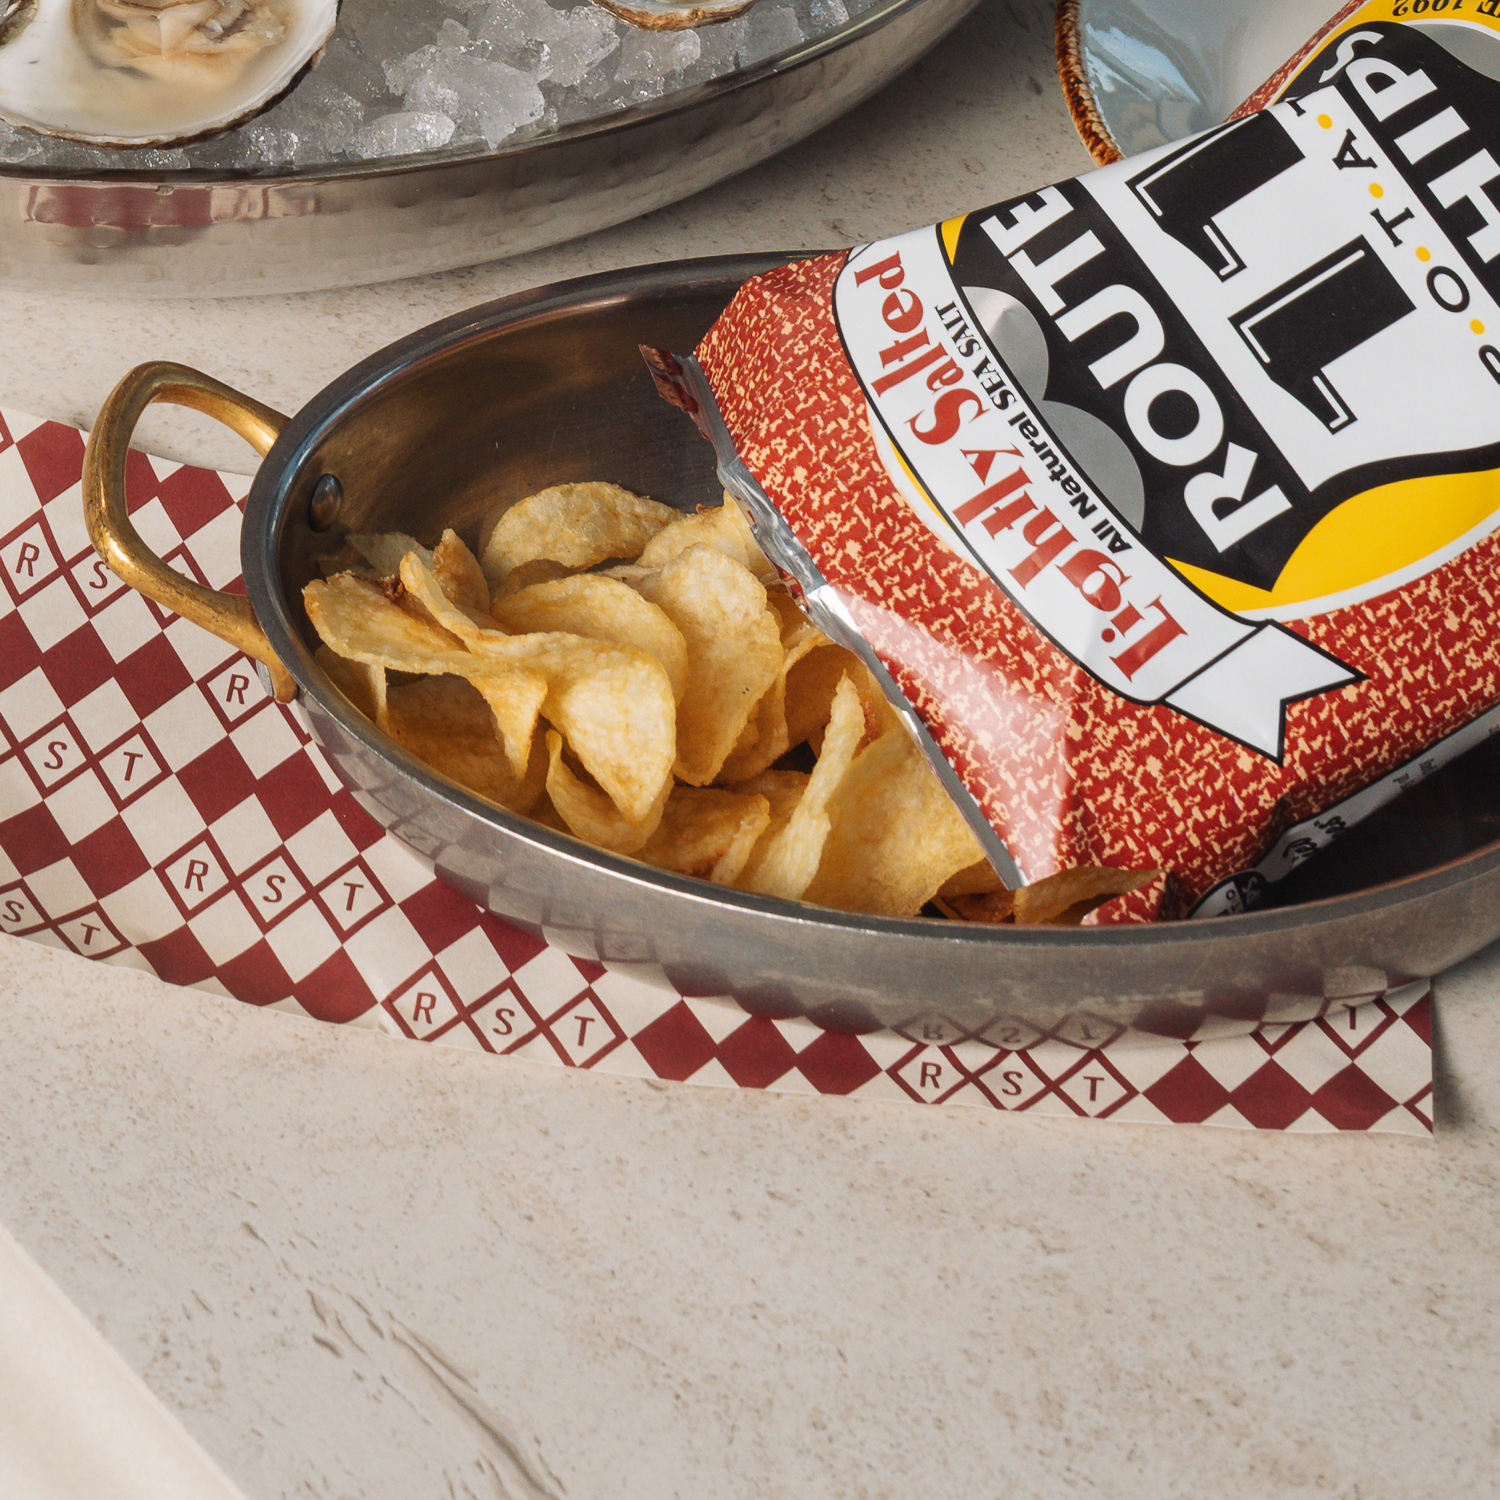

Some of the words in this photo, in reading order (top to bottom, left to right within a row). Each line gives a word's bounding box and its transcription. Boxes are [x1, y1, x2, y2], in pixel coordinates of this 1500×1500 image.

[854, 250, 991, 446] Salted
[934, 300, 985, 359] SALT
[973, 353, 1018, 410] SEA
[979, 185, 1294, 553] ROUTE
[1007, 411, 1099, 519] Natural
[951, 442, 1189, 683] Lightly
[1091, 512, 1133, 554] All
